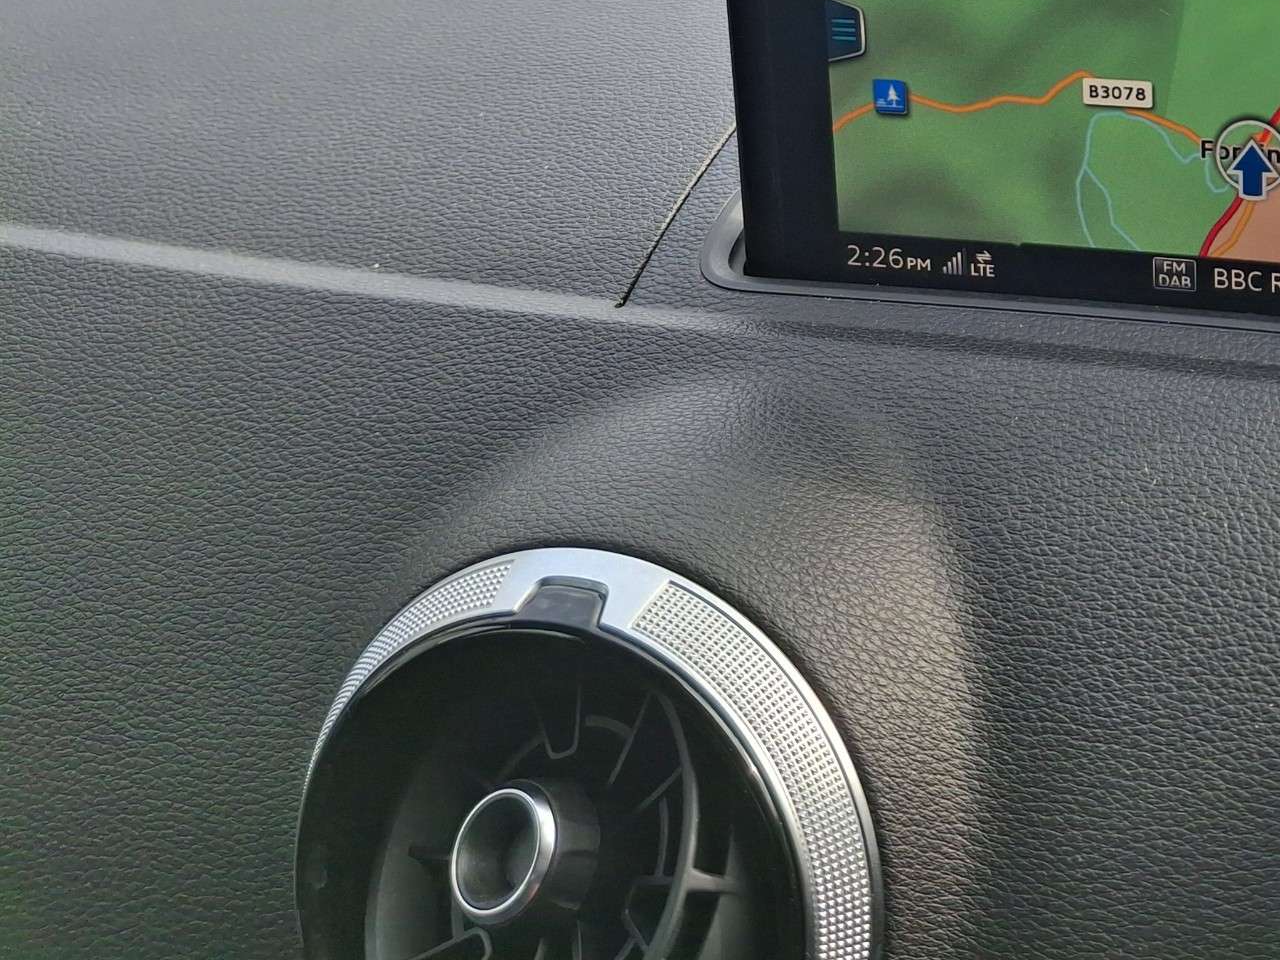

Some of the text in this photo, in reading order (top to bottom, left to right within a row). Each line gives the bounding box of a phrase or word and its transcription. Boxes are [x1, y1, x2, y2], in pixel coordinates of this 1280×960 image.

[1088, 84, 1147, 102] B3078
[970, 262, 995, 278] LTE
[1163, 261, 1187, 274] FM
[1158, 274, 1192, 289] DAB
[1213, 267, 1263, 292] BBC
